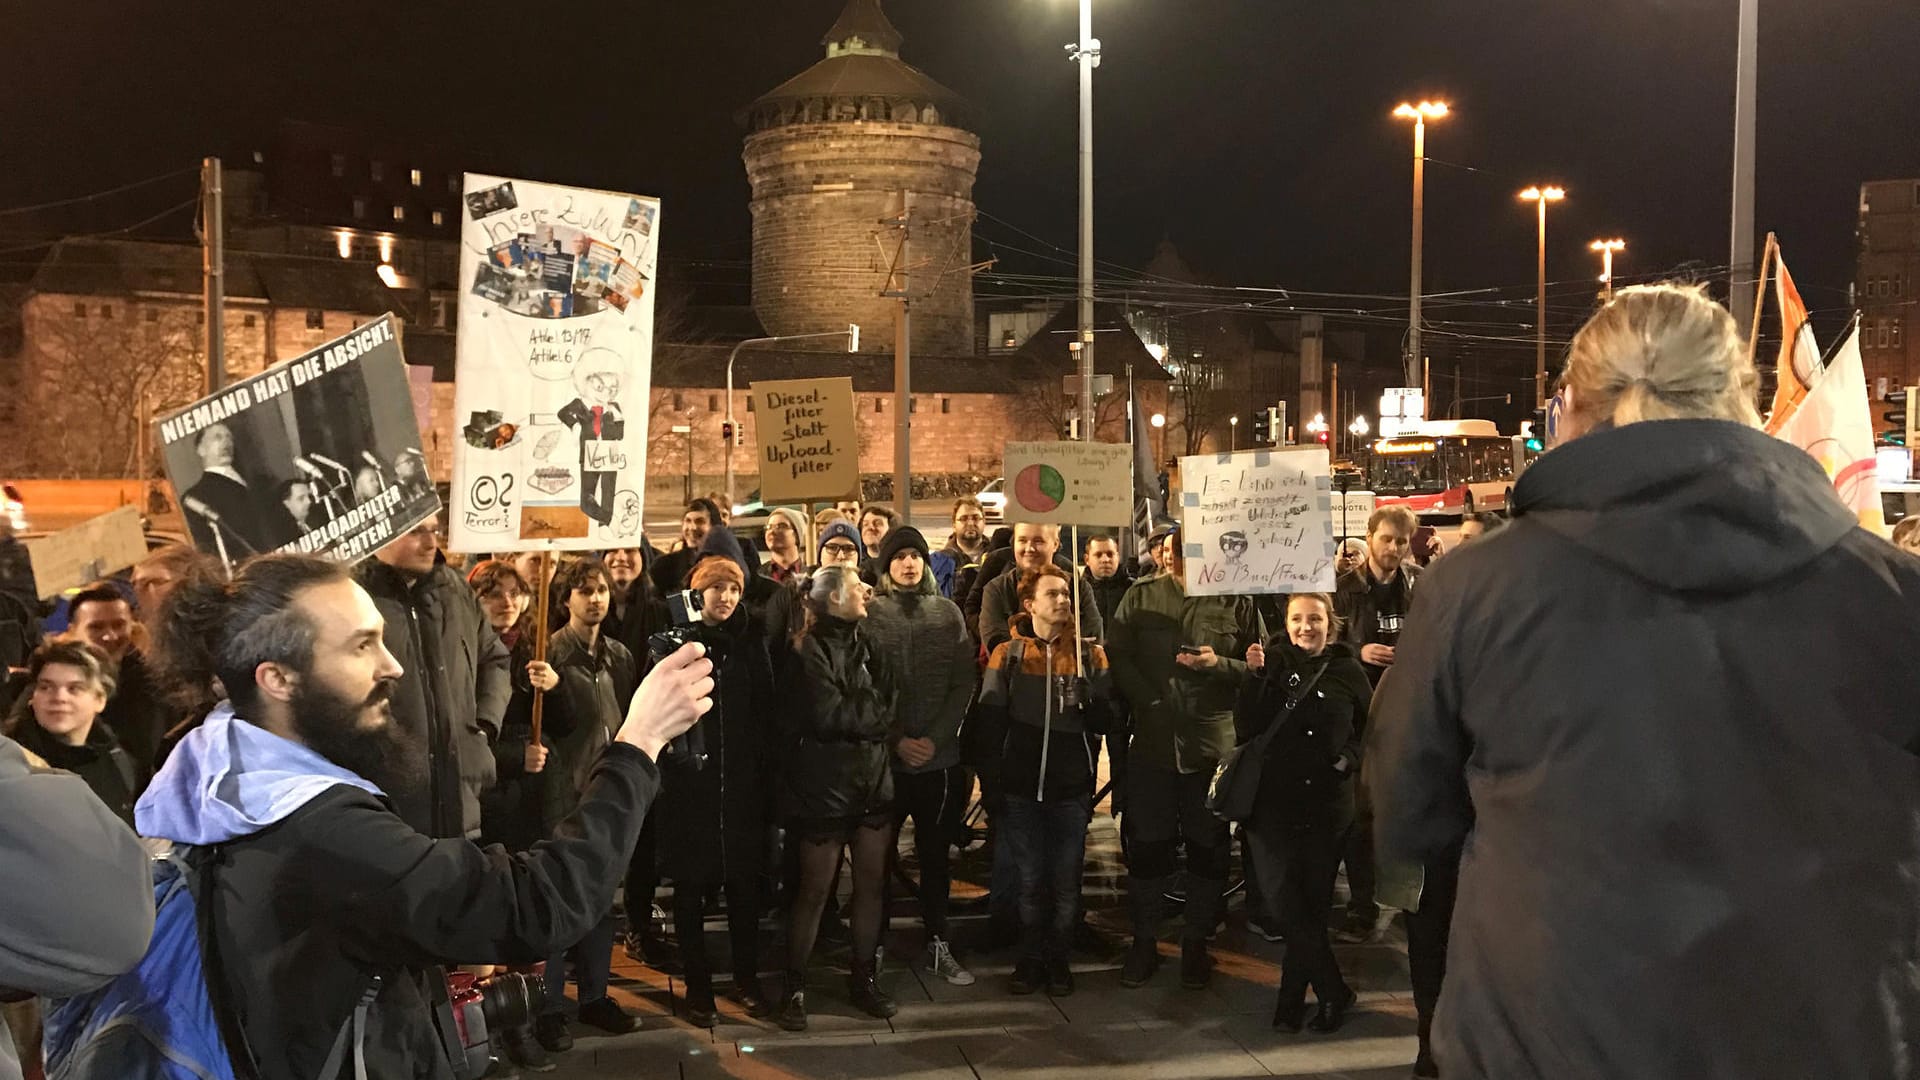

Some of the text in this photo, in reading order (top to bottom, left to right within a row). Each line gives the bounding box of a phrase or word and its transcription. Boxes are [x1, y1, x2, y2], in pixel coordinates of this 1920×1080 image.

[564, 349, 573, 364] 6
[161, 319, 394, 444] NIEMAND HAT DIE ABSICHT,
[766, 388, 828, 409] Diesel-
[785, 407, 824, 425] filter
[587, 443, 627, 470] Verlag
[766, 439, 841, 464] Upload-
[791, 461, 833, 479] filter
[299, 484, 401, 553] UPLOADFILTER
